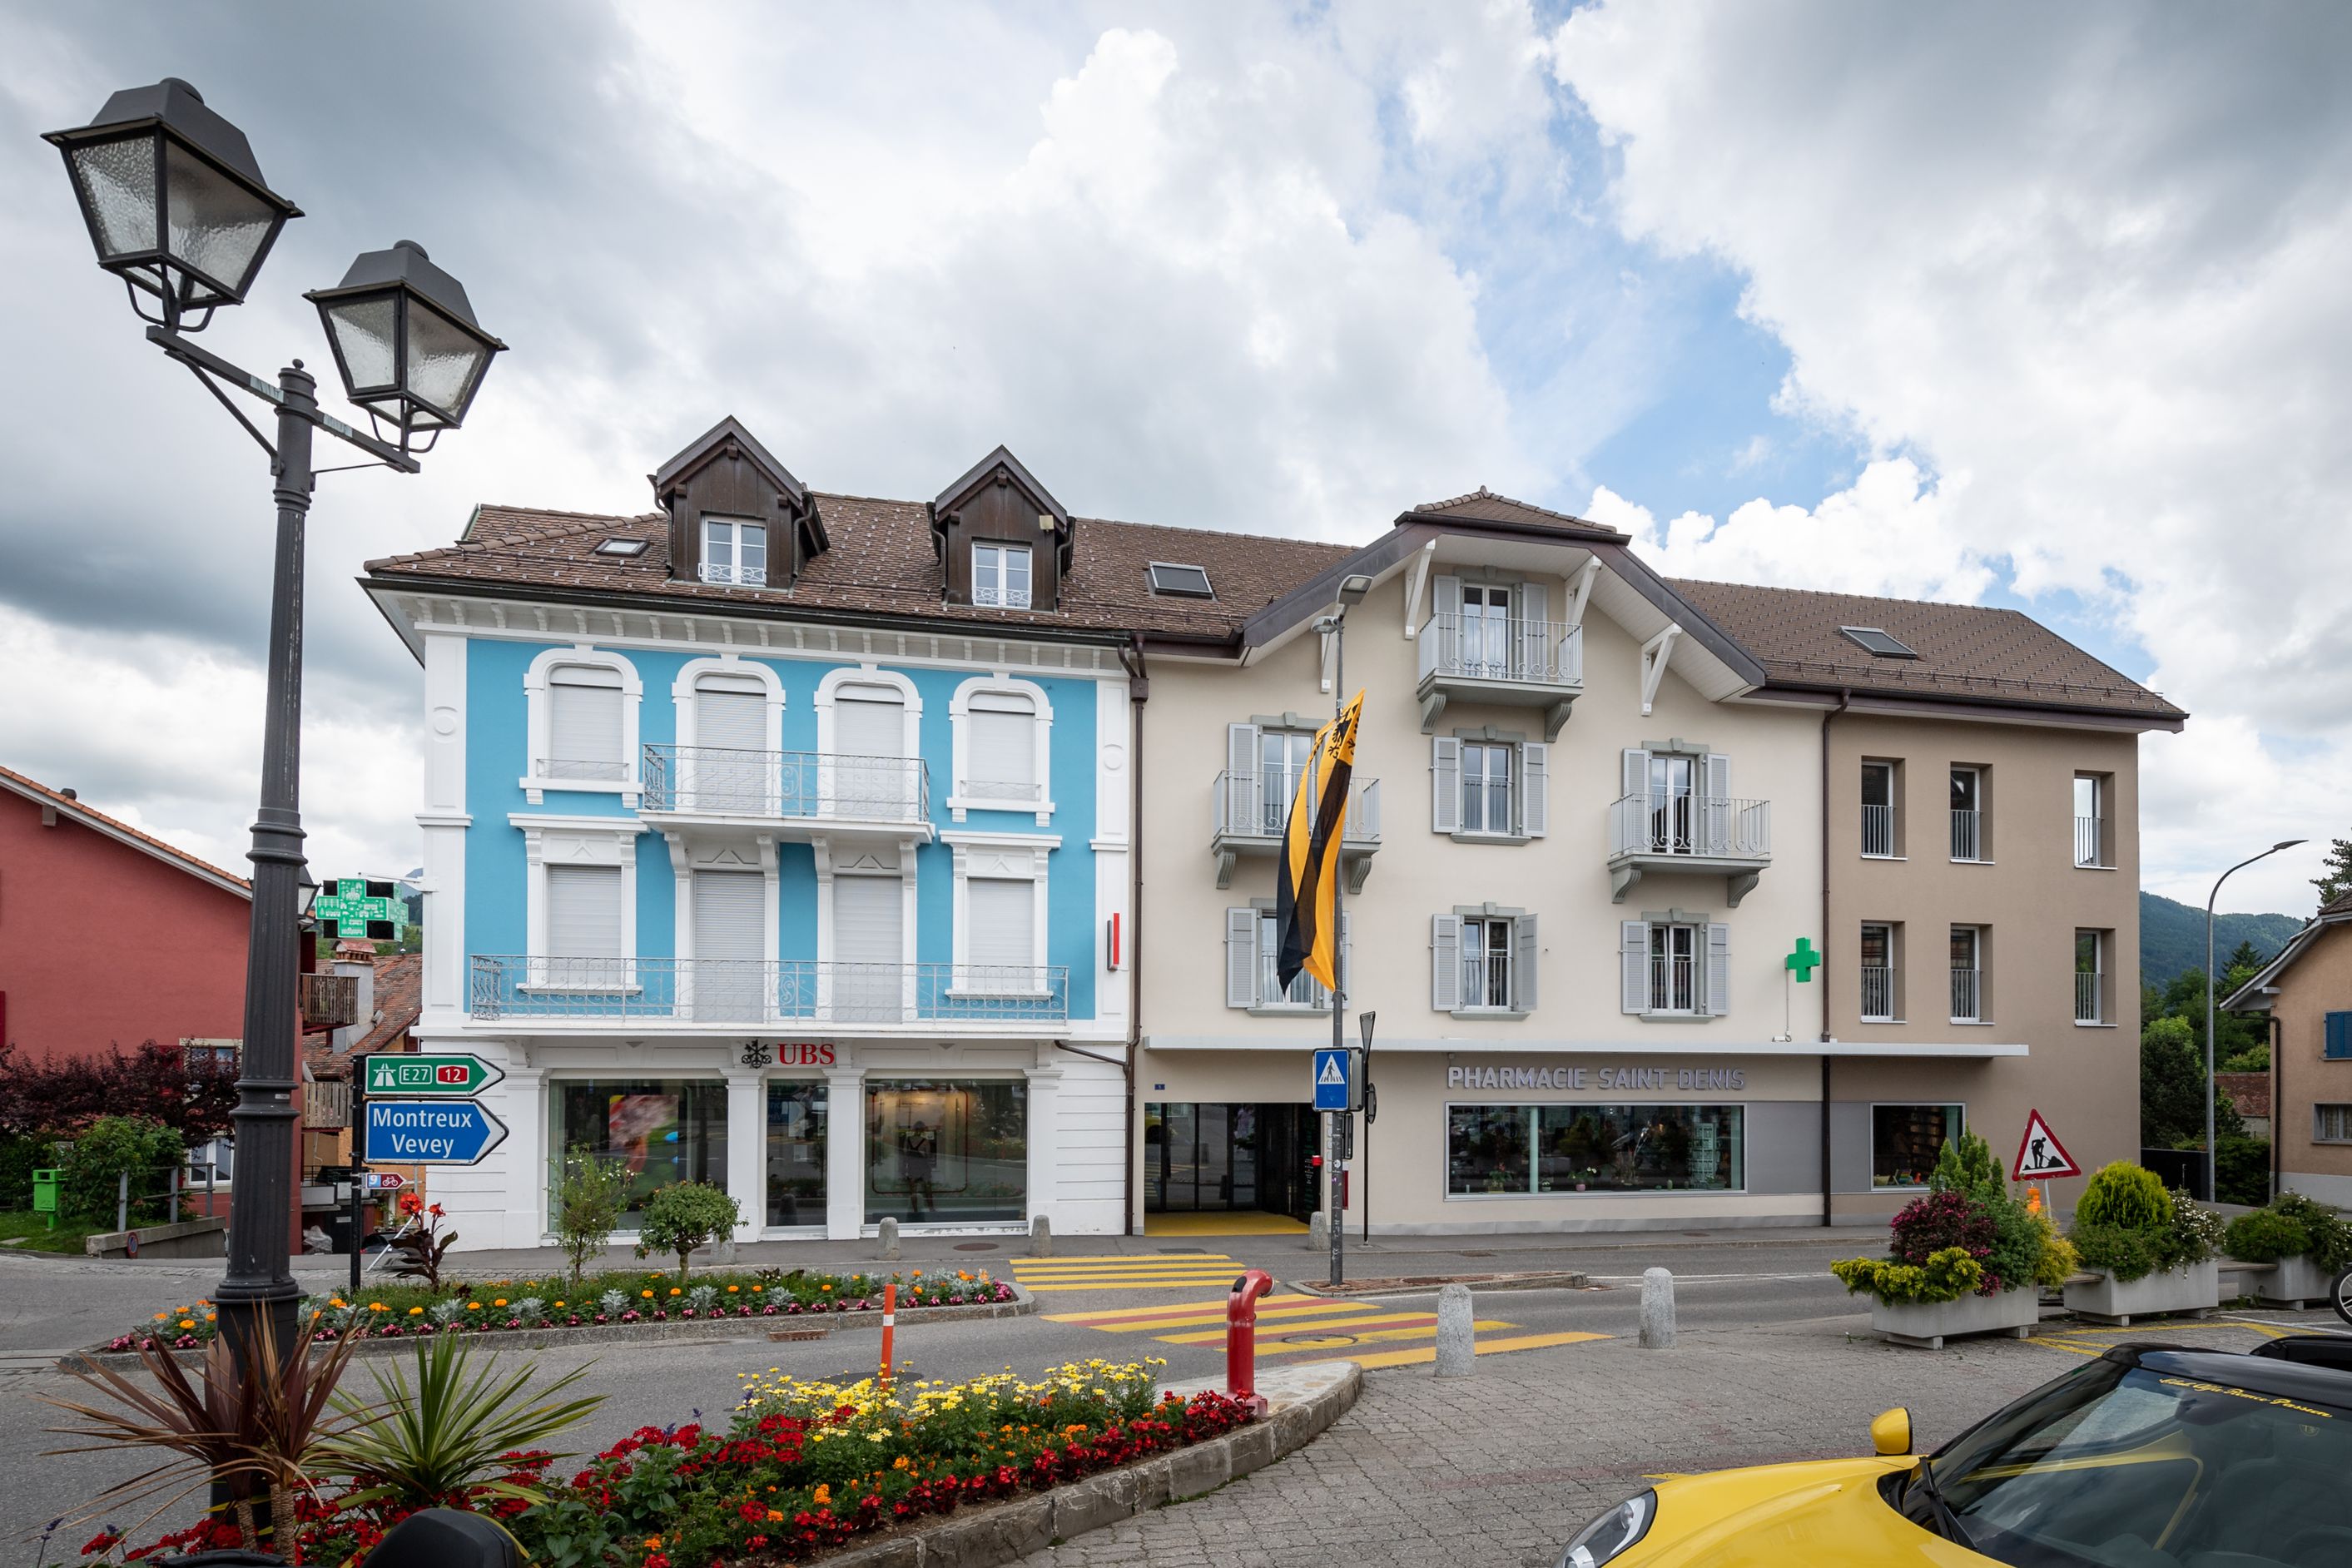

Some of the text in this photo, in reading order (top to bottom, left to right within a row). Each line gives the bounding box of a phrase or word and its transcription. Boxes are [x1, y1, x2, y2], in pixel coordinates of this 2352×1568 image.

[777, 1043, 835, 1065] UBS
[444, 1069, 461, 1081] 12
[1447, 1066, 1745, 1090] PHARMACIE SAINT DENIS
[373, 1108, 472, 1128] Montreux
[391, 1134, 454, 1159] Vevey
[370, 1174, 378, 1185] 9
